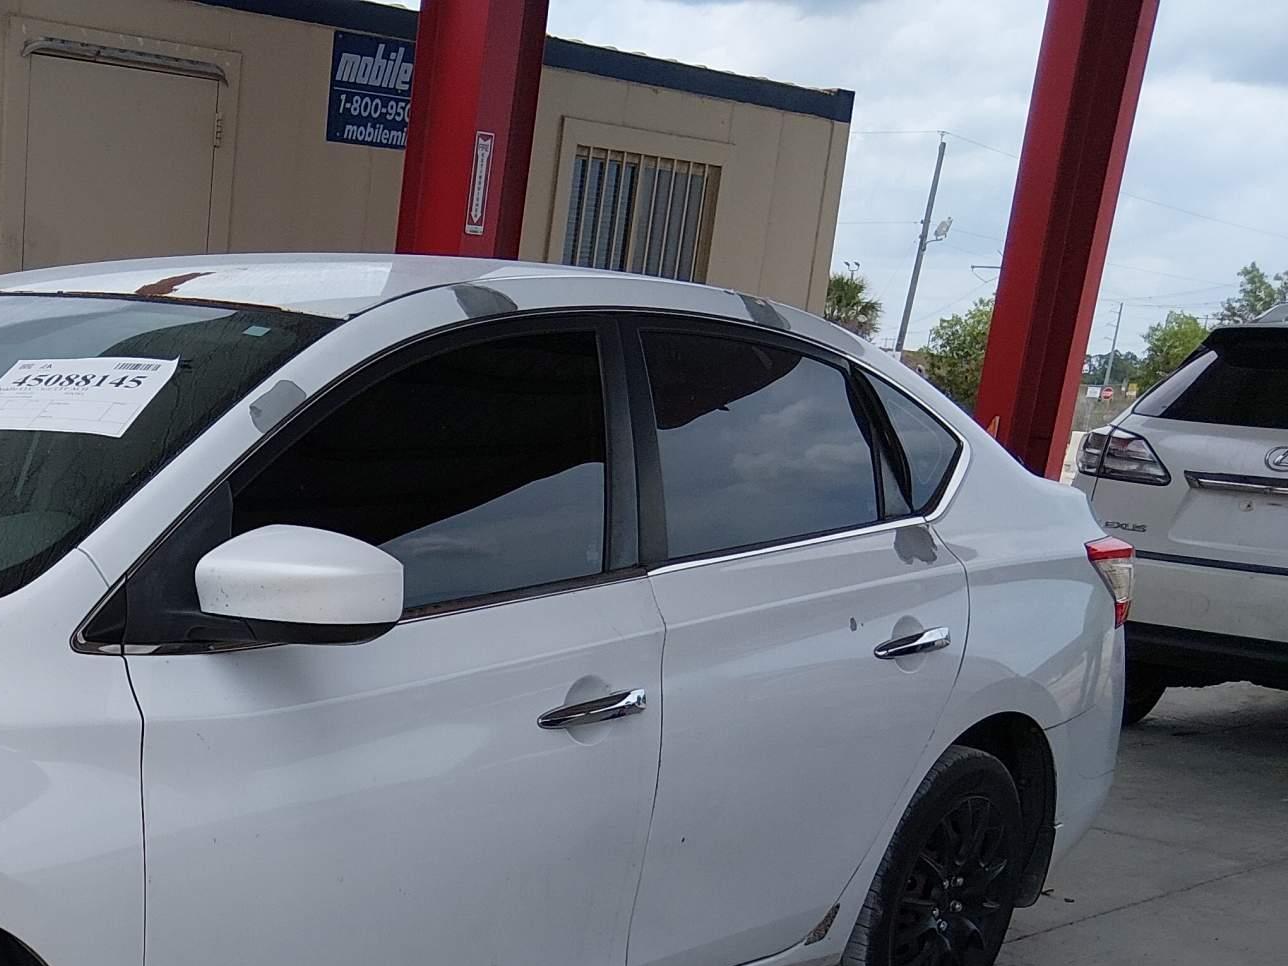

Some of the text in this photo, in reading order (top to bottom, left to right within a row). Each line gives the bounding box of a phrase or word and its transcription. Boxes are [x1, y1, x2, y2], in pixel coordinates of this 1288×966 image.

[335, 43, 414, 90] mobile
[11, 372, 148, 389] 45088145
[1104, 520, 1147, 534] EXUS
